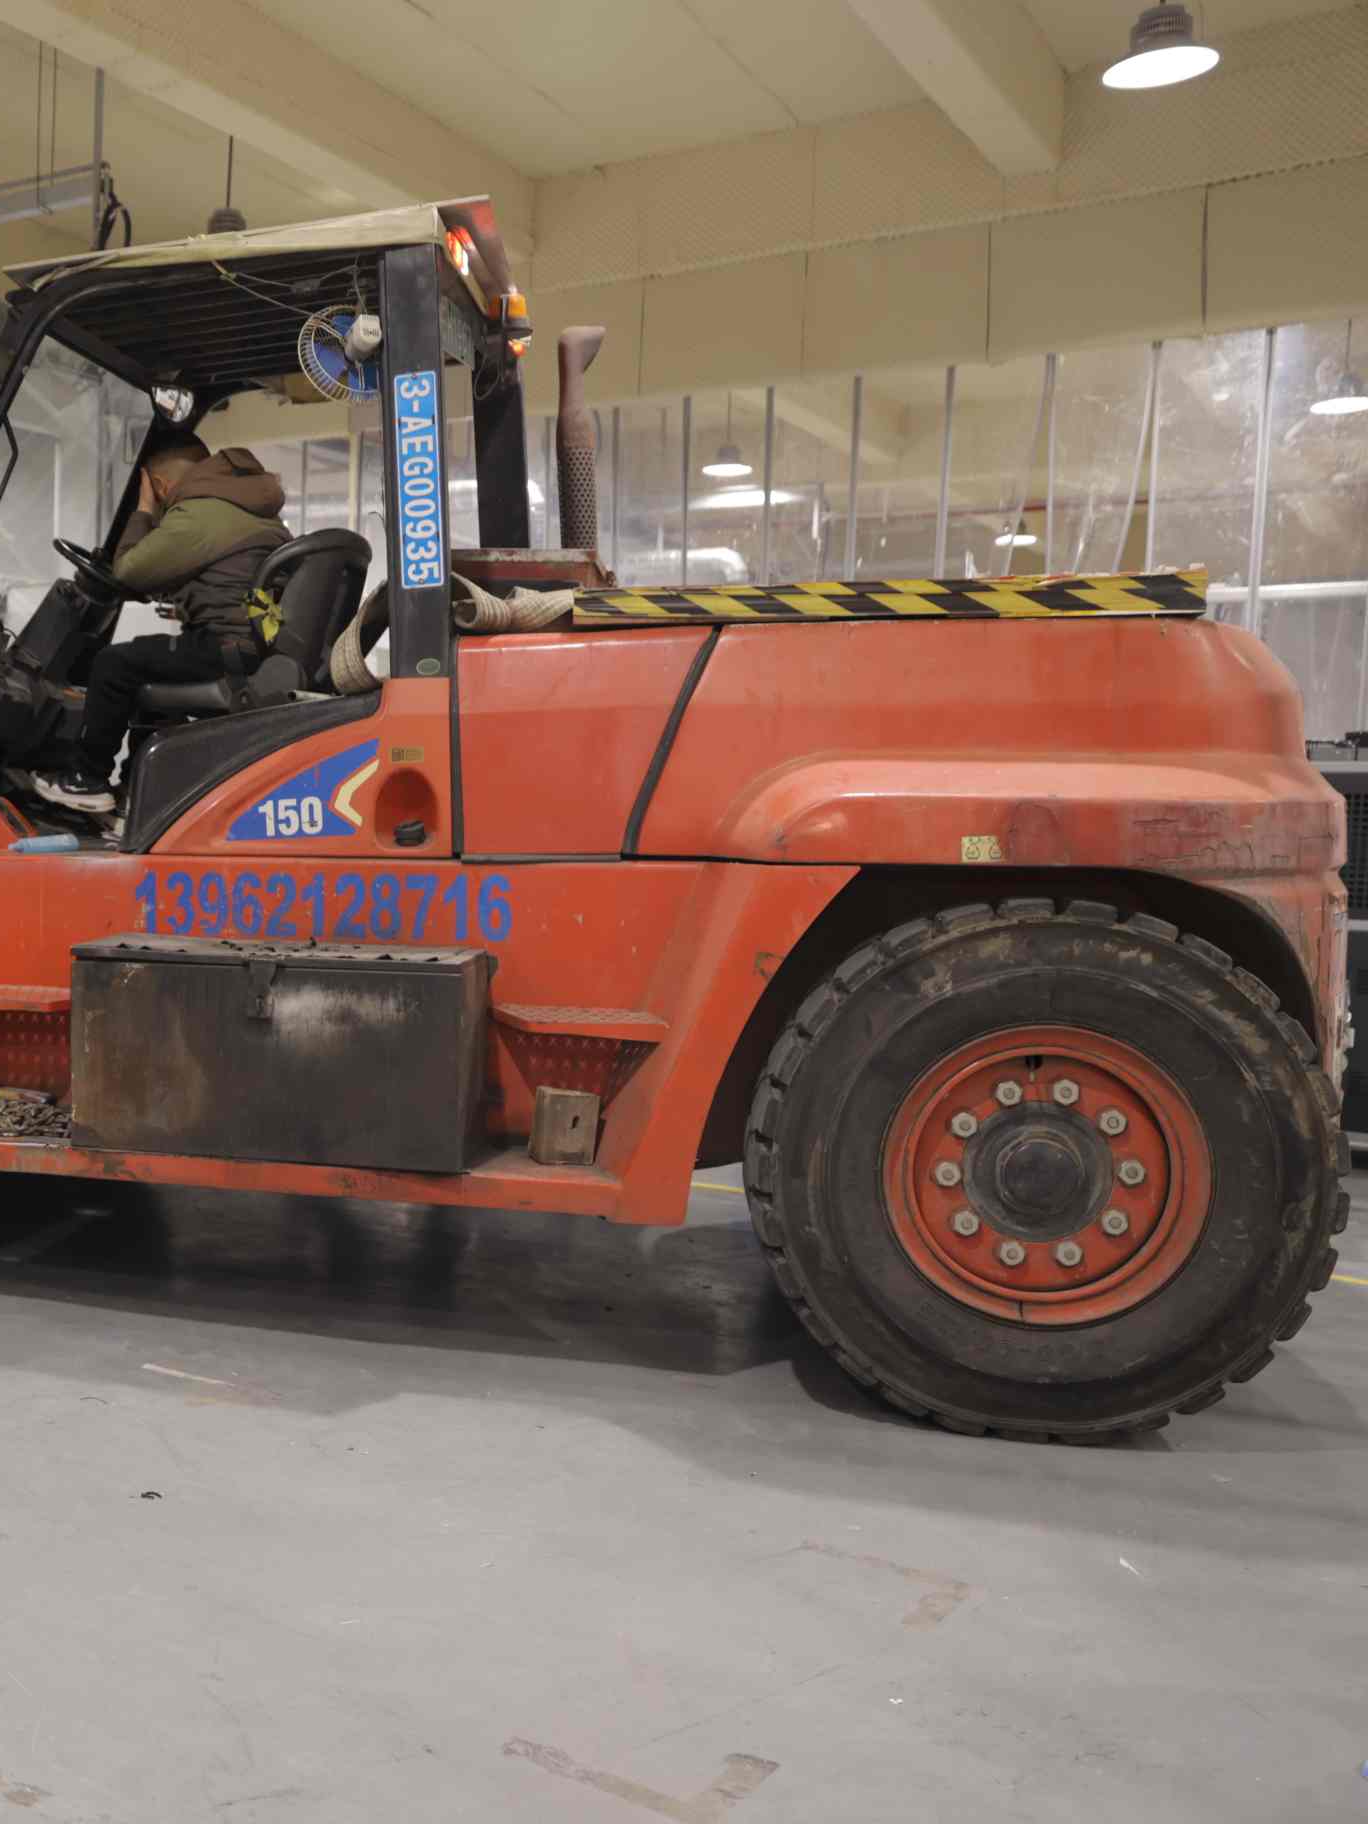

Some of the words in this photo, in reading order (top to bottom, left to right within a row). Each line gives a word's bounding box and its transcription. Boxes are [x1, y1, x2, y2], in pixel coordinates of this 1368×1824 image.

[400, 379, 440, 582] 3-AEG00935
[258, 796, 323, 837] 150
[135, 869, 512, 941] 13962128716
